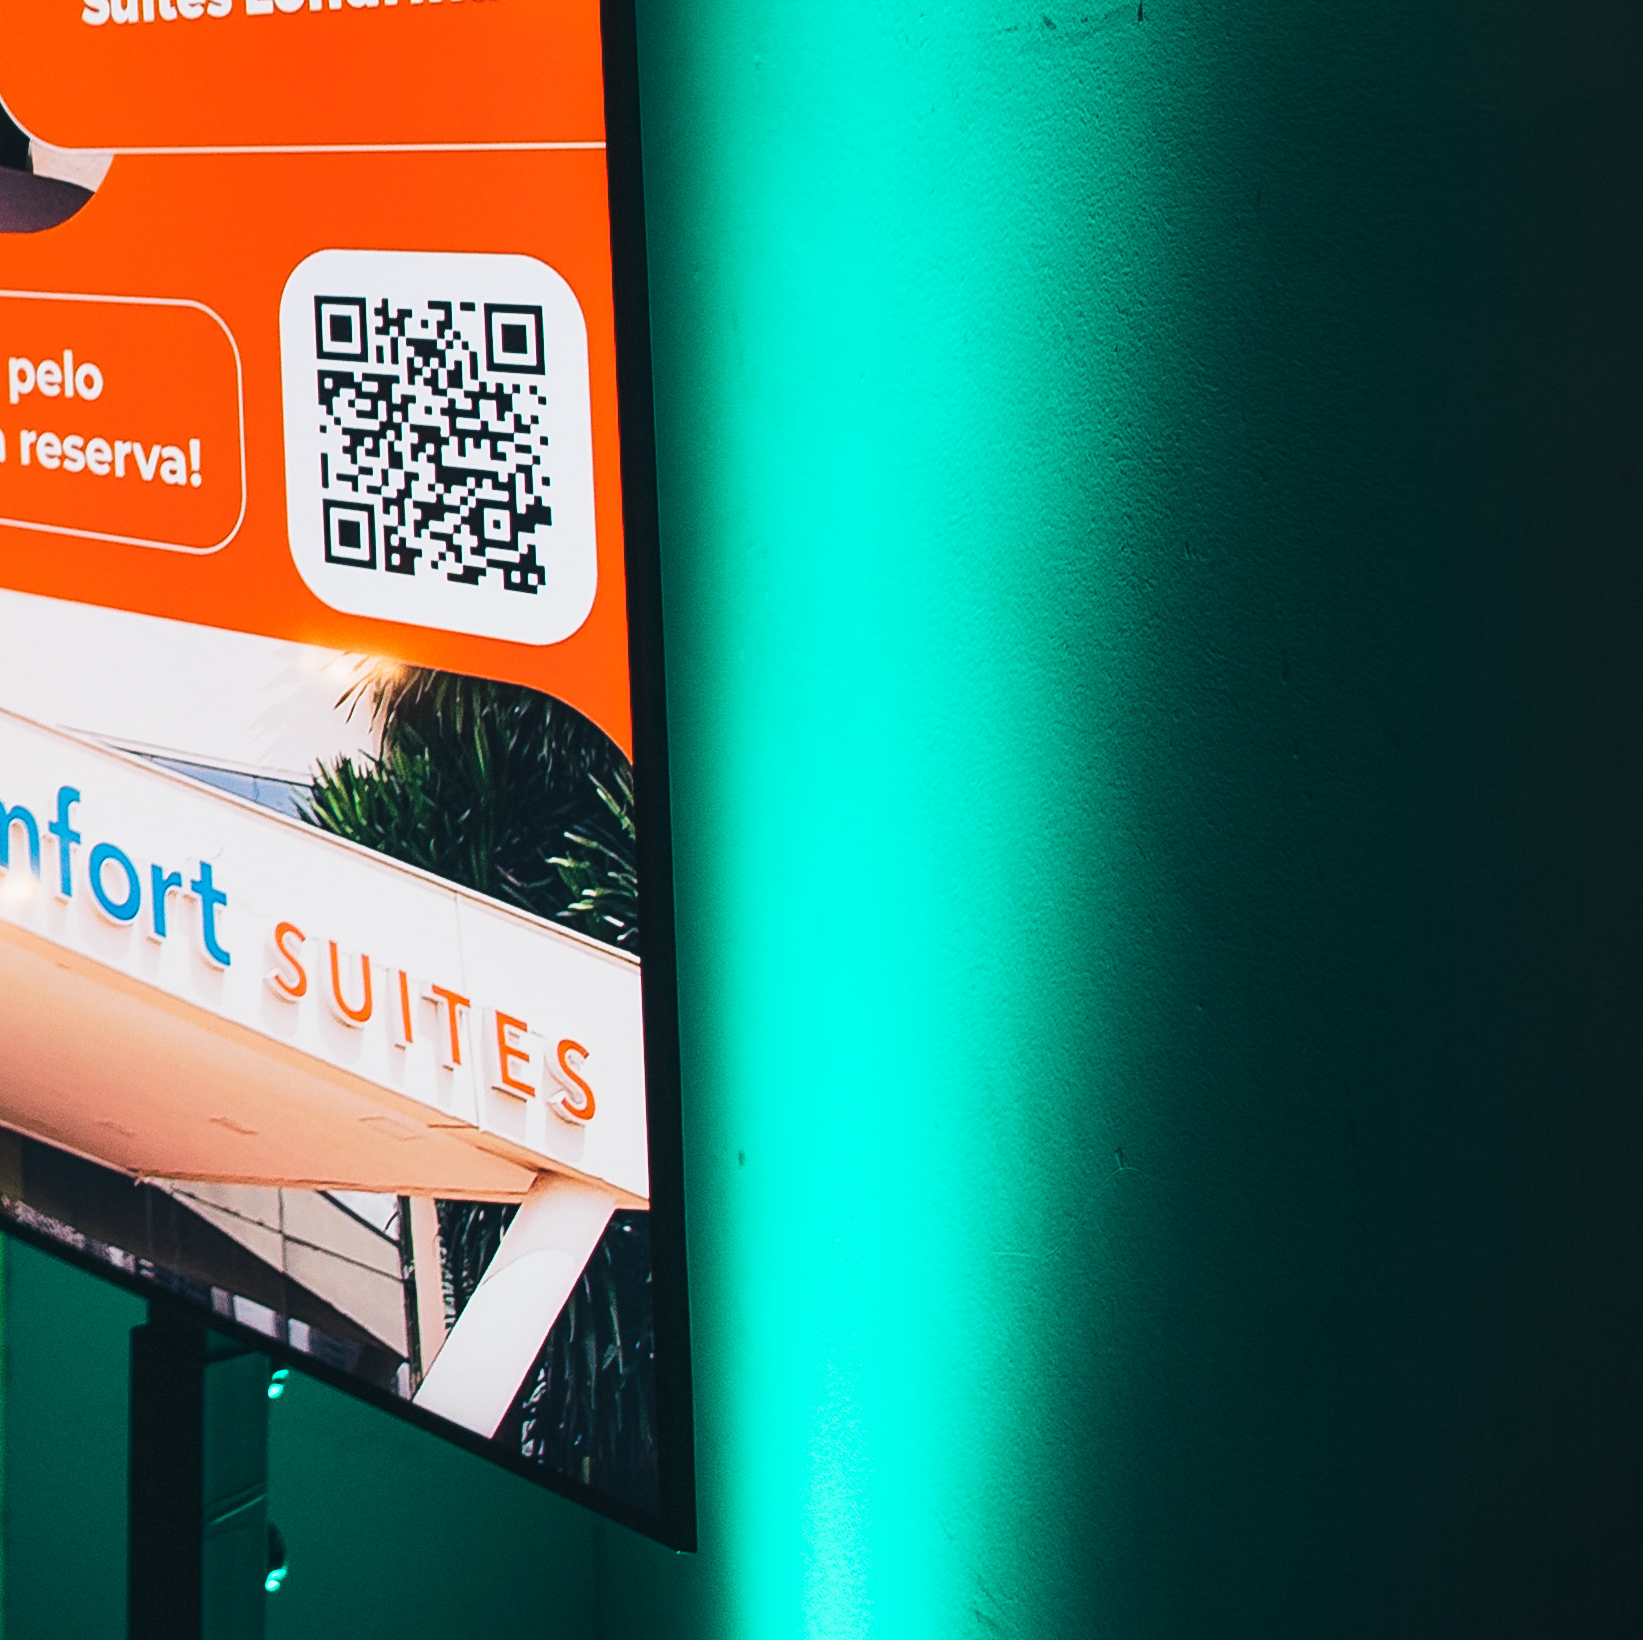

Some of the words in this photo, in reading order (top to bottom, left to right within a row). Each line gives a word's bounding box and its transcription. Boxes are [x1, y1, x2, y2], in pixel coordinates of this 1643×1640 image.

[8, 349, 104, 405] pelo
[18, 429, 203, 488] reserva!
[268, 920, 598, 1122] SUITES
